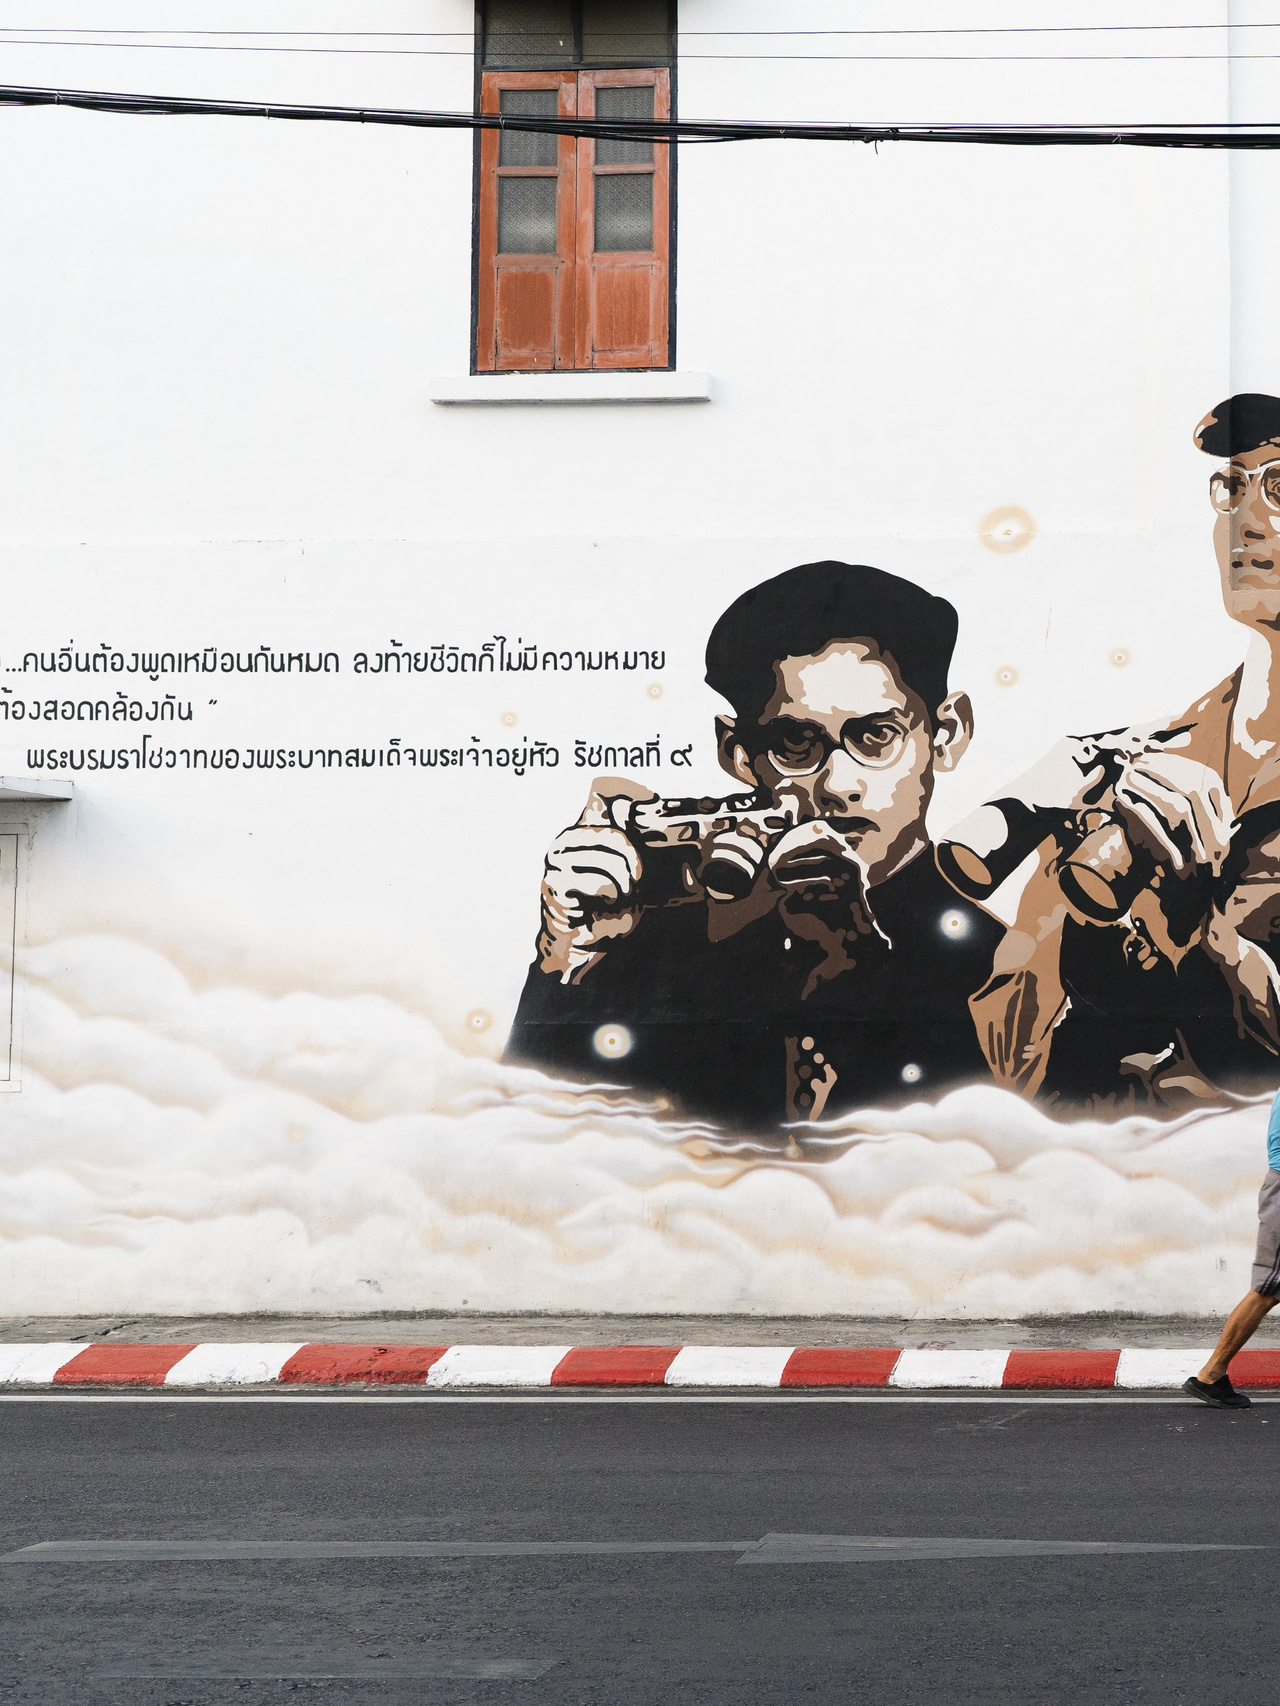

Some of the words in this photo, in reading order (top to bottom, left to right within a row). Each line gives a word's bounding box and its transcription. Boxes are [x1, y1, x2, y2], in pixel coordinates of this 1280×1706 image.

[353, 634, 666, 674] ลงท้ายชีวิตก็ไม่มีความหมาย
[26, 734, 560, 777] พระบรมราโชวาทของพระบาทสมเด็จพระเจ้าอยู่หัว
[574, 733, 661, 768] รัชกาลที่
[670, 743, 693, 767] ๙
